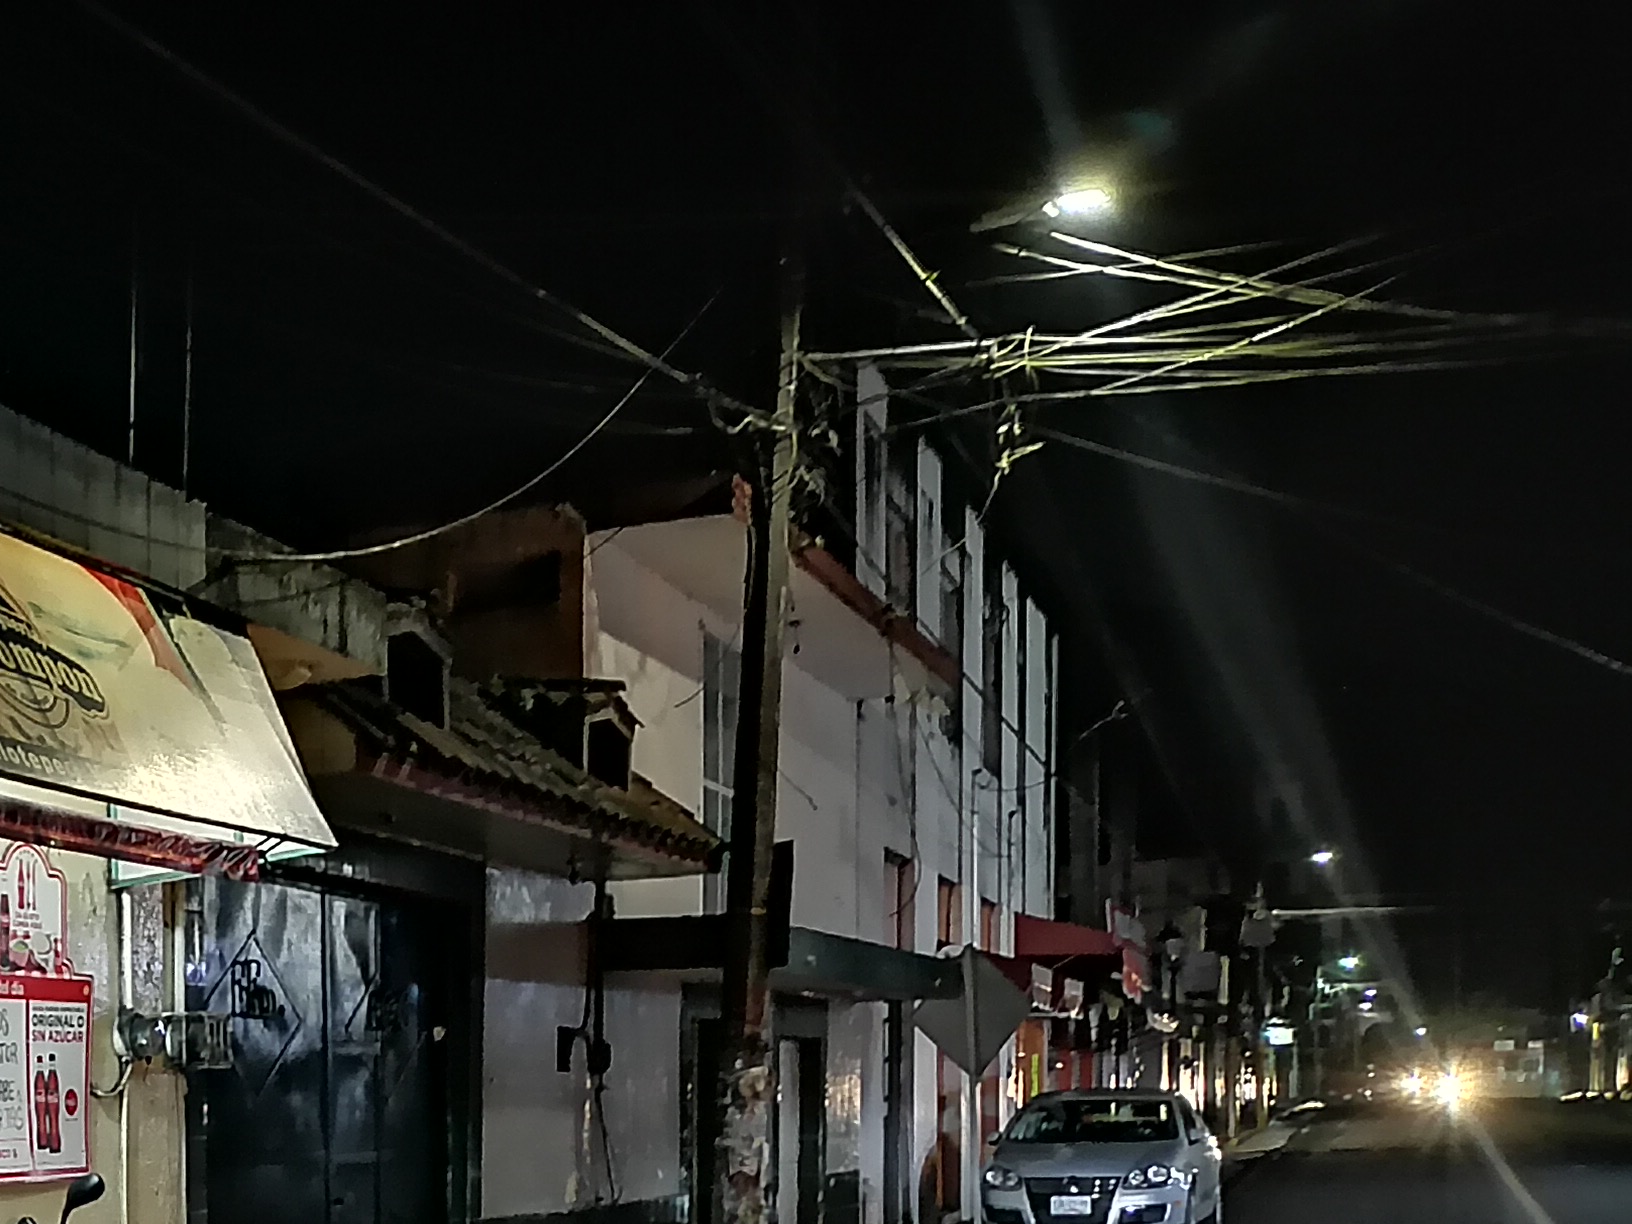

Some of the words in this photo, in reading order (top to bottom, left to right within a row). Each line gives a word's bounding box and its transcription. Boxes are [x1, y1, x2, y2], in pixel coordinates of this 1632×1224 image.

[32, 1013, 74, 1028] ORIGINAL
[77, 1015, 85, 1028] O
[32, 1029, 46, 1043] SIN
